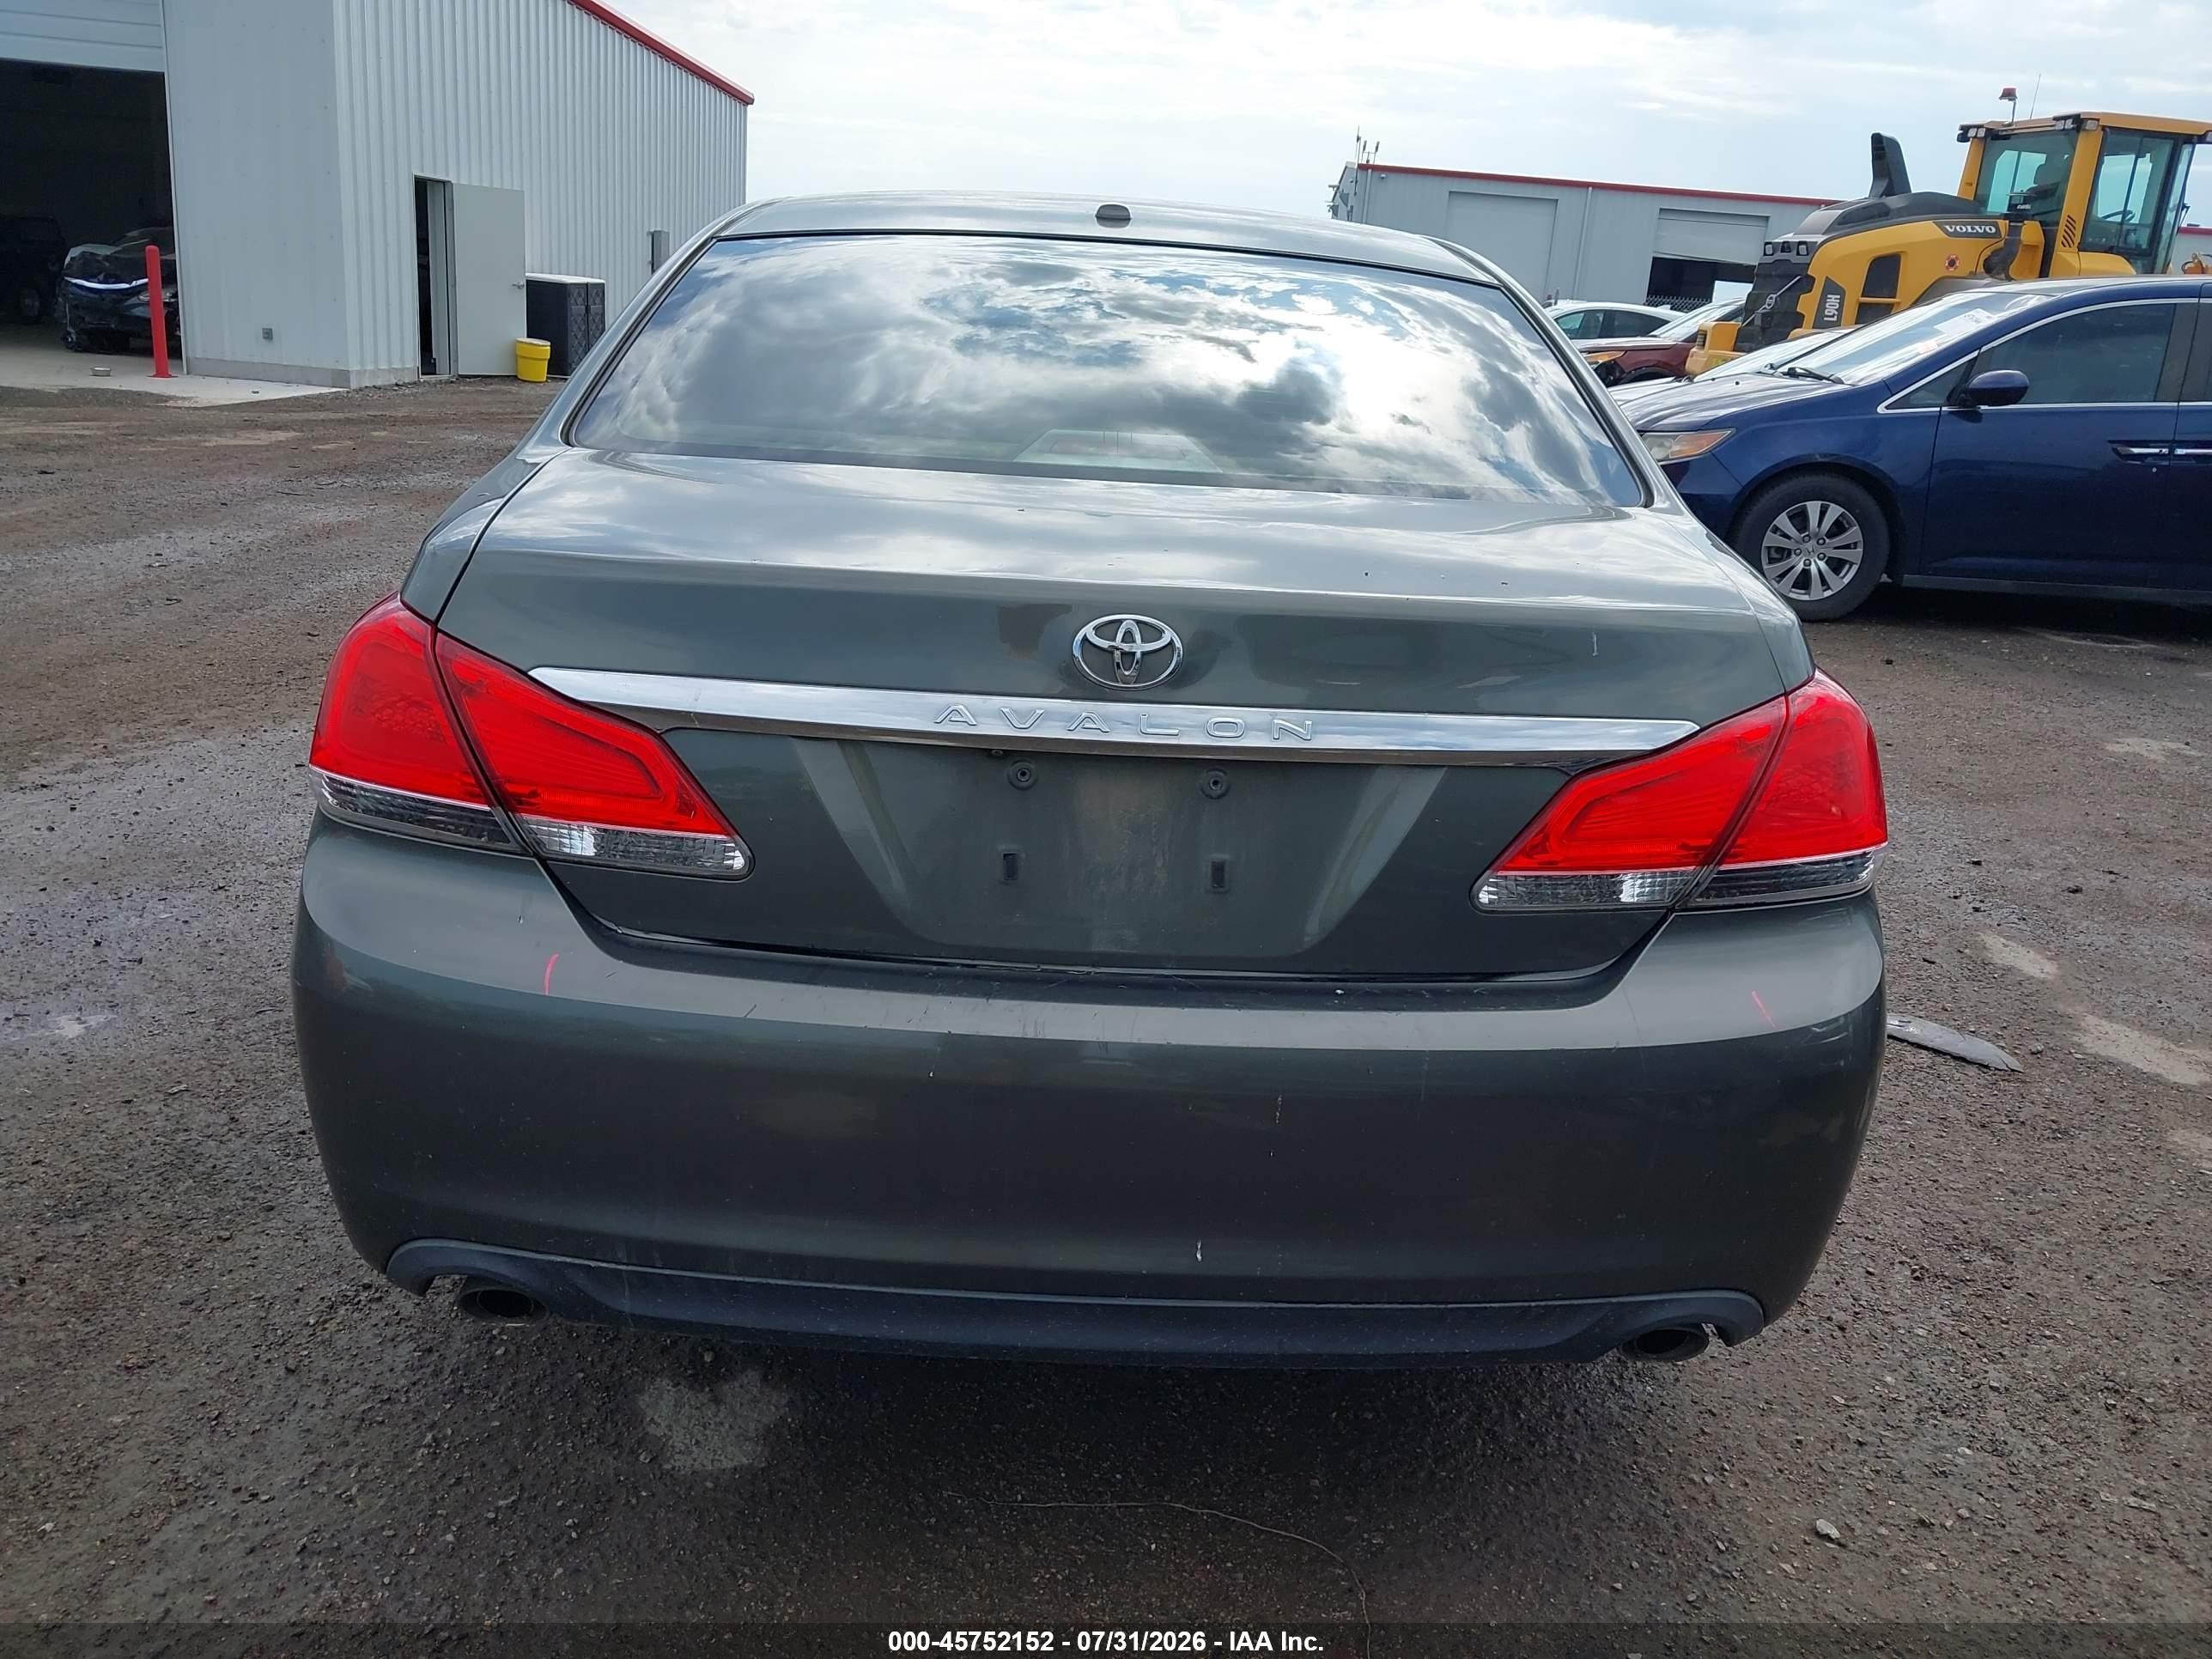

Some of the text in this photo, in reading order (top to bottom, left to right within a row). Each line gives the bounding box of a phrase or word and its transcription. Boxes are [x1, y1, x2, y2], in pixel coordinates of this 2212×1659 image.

[1943, 225, 1996, 234] VOLVO
[1823, 294, 1841, 322] L90H
[933, 703, 1313, 743] AVALON
